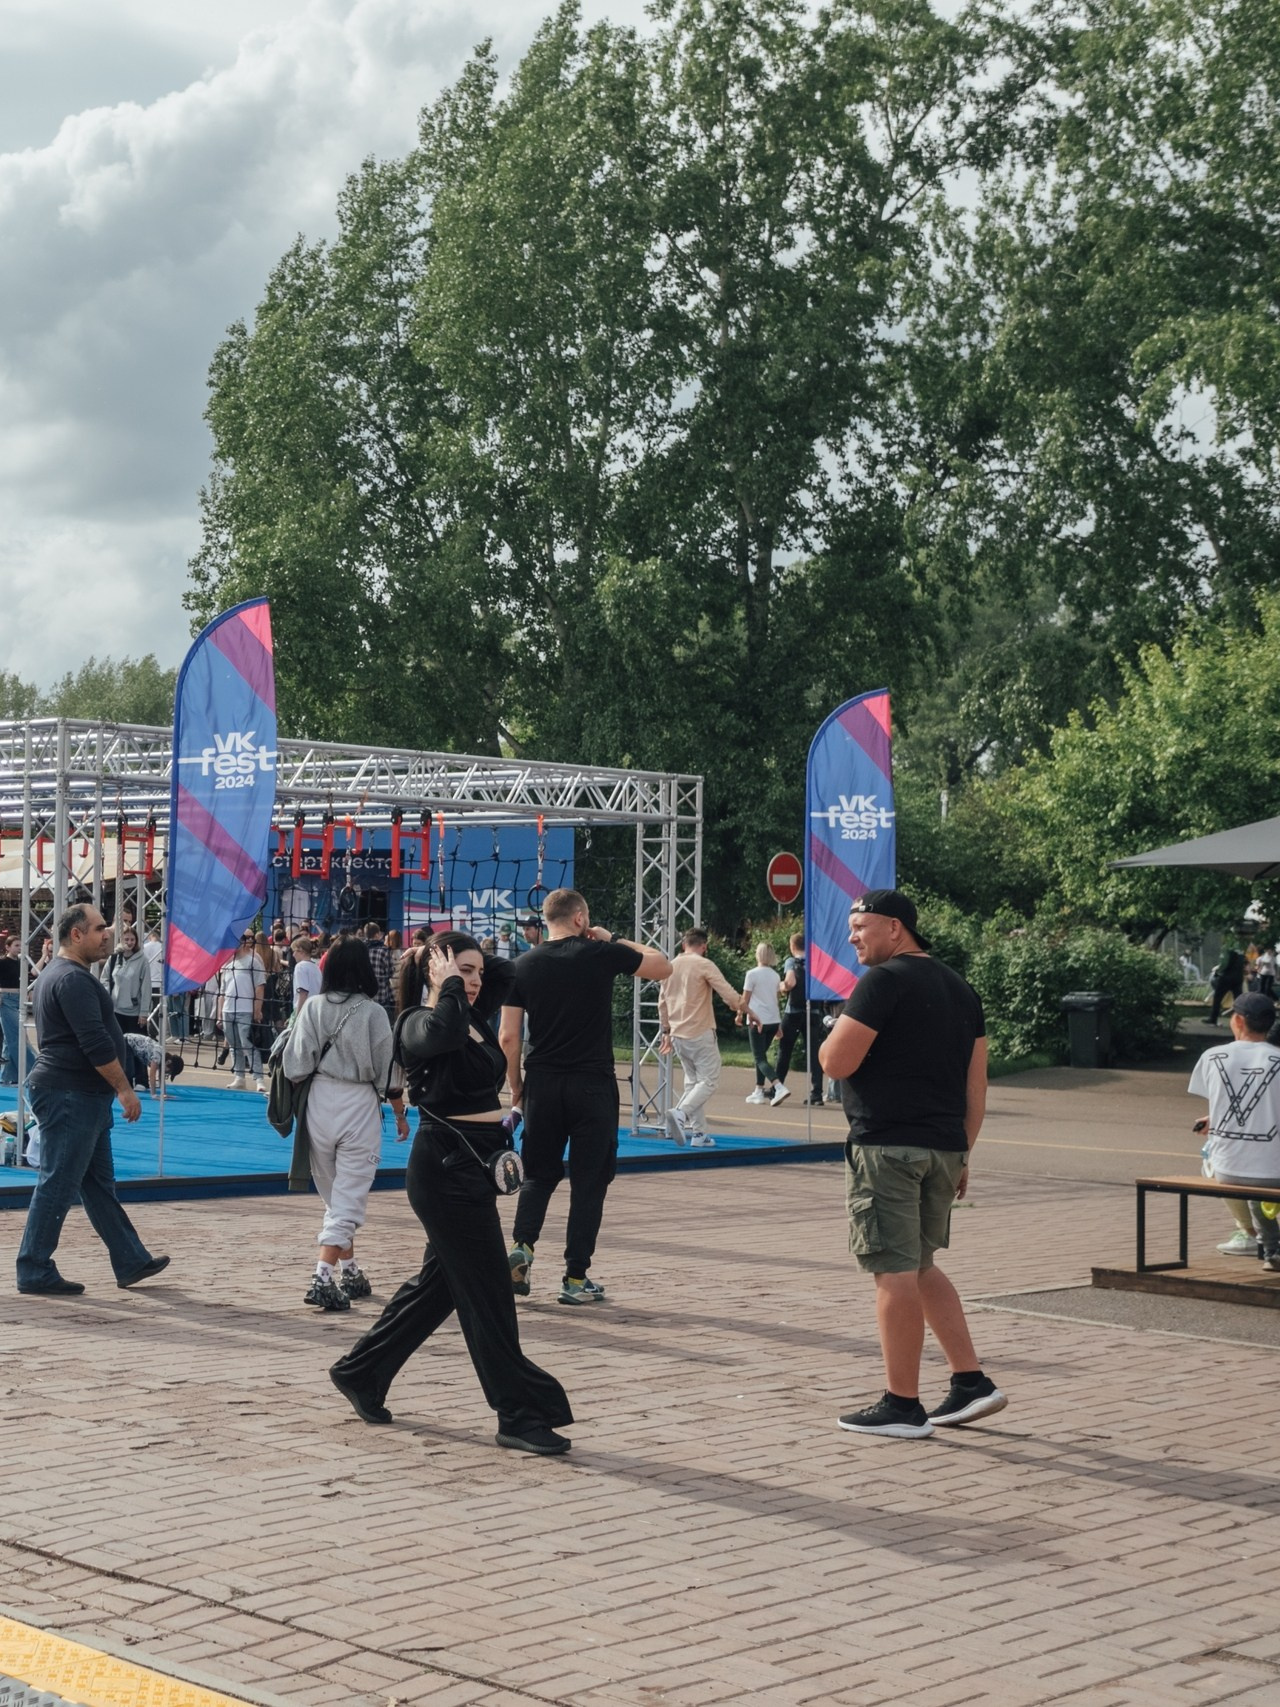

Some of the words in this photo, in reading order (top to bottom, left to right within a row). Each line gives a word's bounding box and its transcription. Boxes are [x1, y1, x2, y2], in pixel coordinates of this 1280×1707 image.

[213, 731, 256, 753] VK
[201, 745, 274, 776] fest
[214, 774, 256, 790] 2024
[838, 795, 878, 812] VK
[827, 805, 892, 829] fest
[841, 829, 877, 840] 2024
[468, 889, 514, 908] VK
